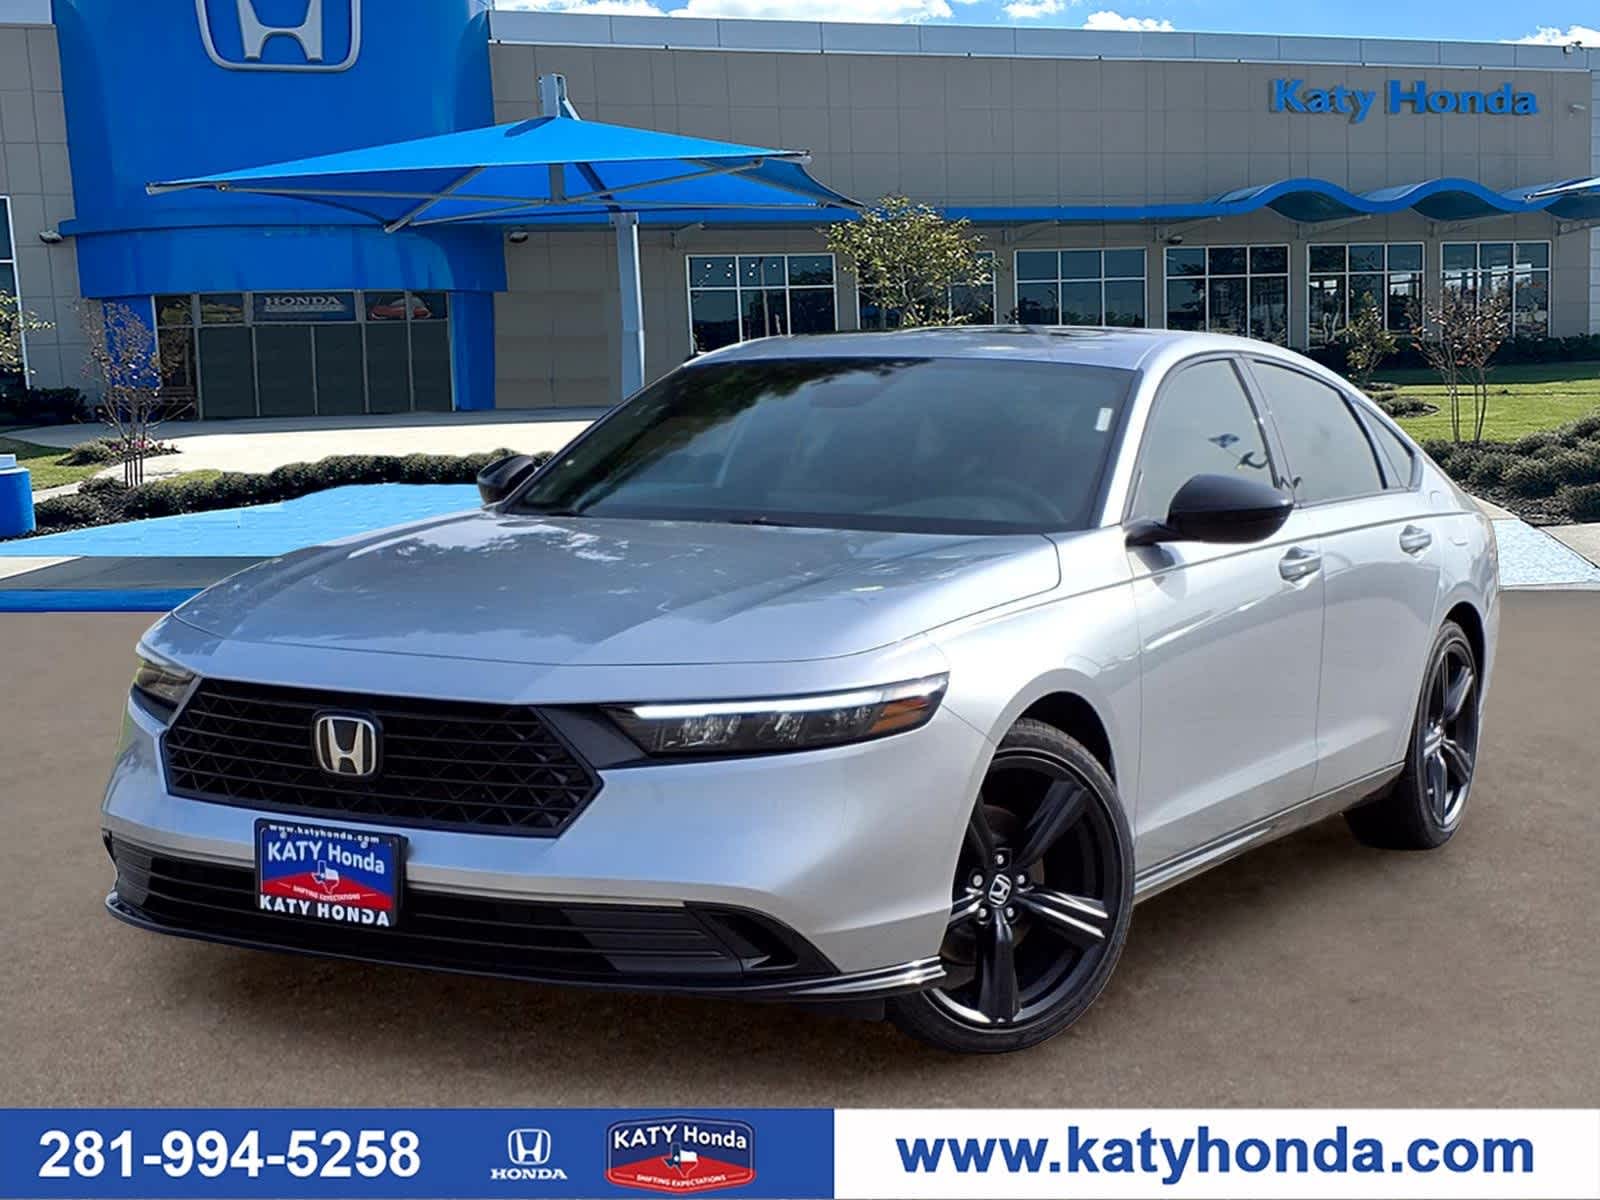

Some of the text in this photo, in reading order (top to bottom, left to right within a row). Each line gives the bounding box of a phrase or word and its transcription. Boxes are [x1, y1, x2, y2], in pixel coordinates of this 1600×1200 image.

[1270, 79, 1538, 123] Katy Honda
[264, 296, 342, 305] HONDA
[269, 824, 380, 843] www.katyhonda.com
[268, 841, 385, 874] KATY Honda
[260, 895, 390, 927] KATY HONDA
